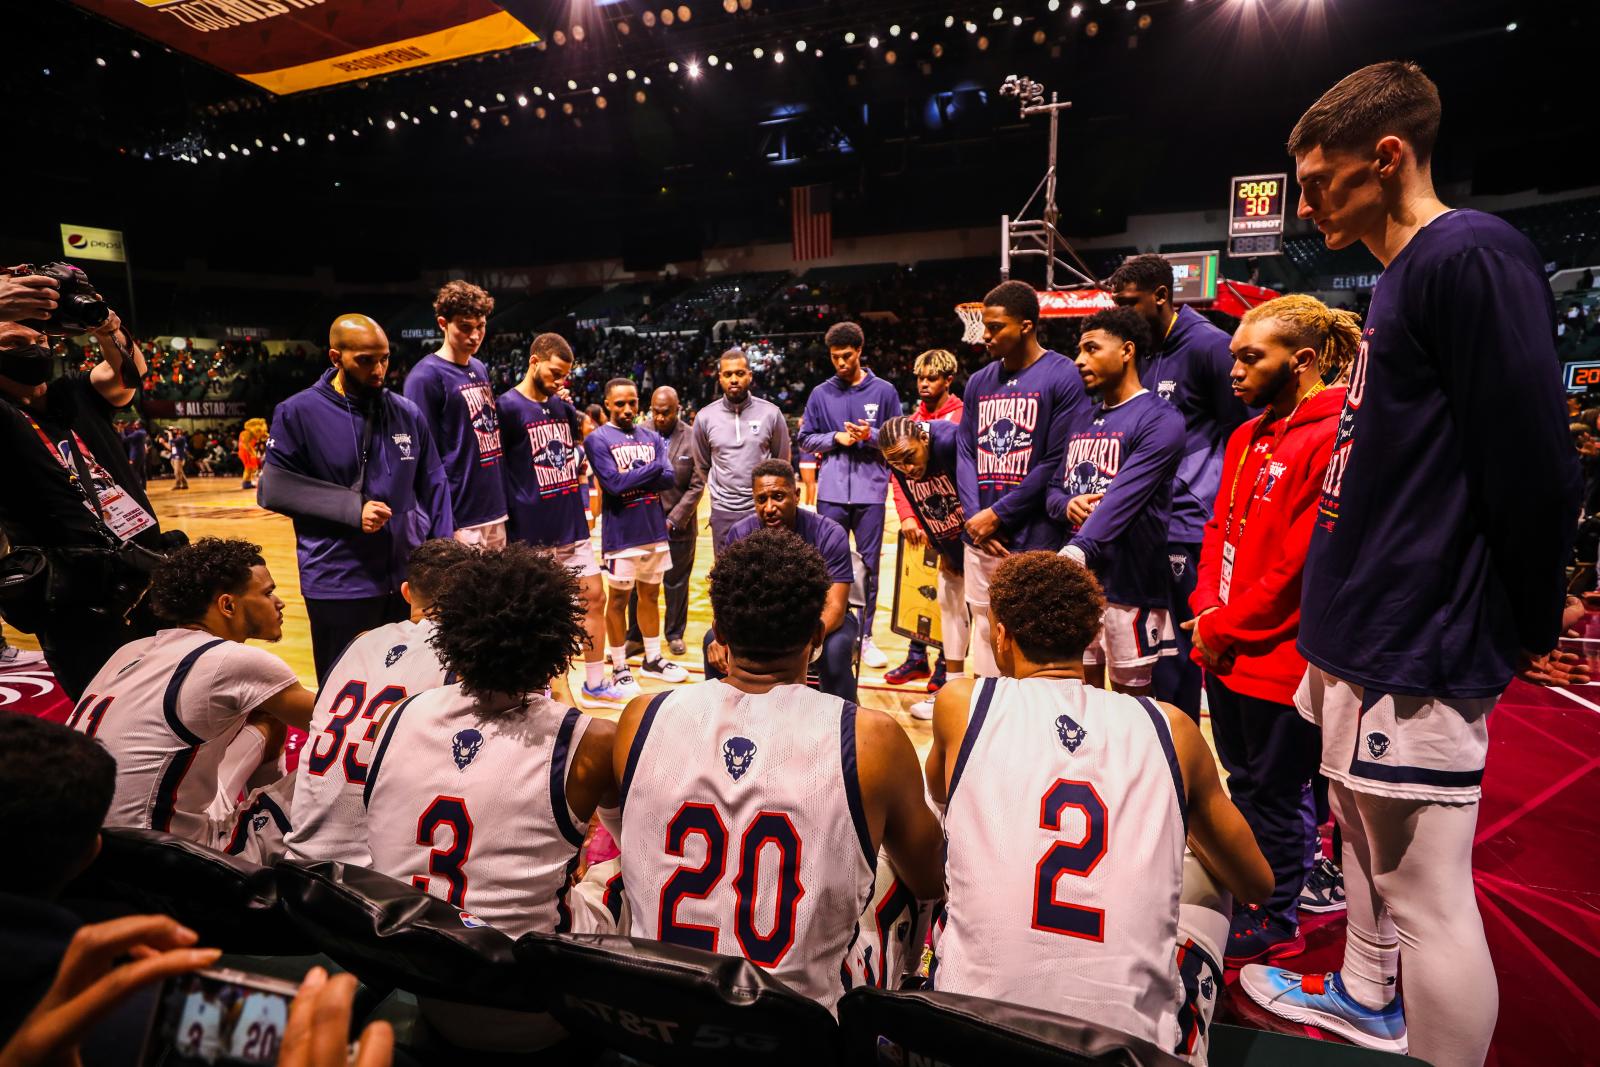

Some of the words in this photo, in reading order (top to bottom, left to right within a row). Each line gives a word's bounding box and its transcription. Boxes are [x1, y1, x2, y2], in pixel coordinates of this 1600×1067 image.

[1239, 181, 1277, 198] 20:00
[1246, 197, 1269, 215] 30
[1247, 220, 1280, 229] TISSOT
[90, 240, 121, 248] pepsi
[1576, 369, 1600, 384] 20
[186, 402, 200, 415] ALL
[202, 402, 225, 415] STAR
[978, 398, 1038, 435] HOWARD
[528, 423, 573, 456] HOWARD
[611, 445, 656, 471] HOWARD
[977, 447, 1032, 475] UNIVERSITY
[309, 680, 407, 785] 33
[412, 794, 474, 910] 3
[1031, 777, 1109, 944] 2
[658, 801, 806, 969] 20
